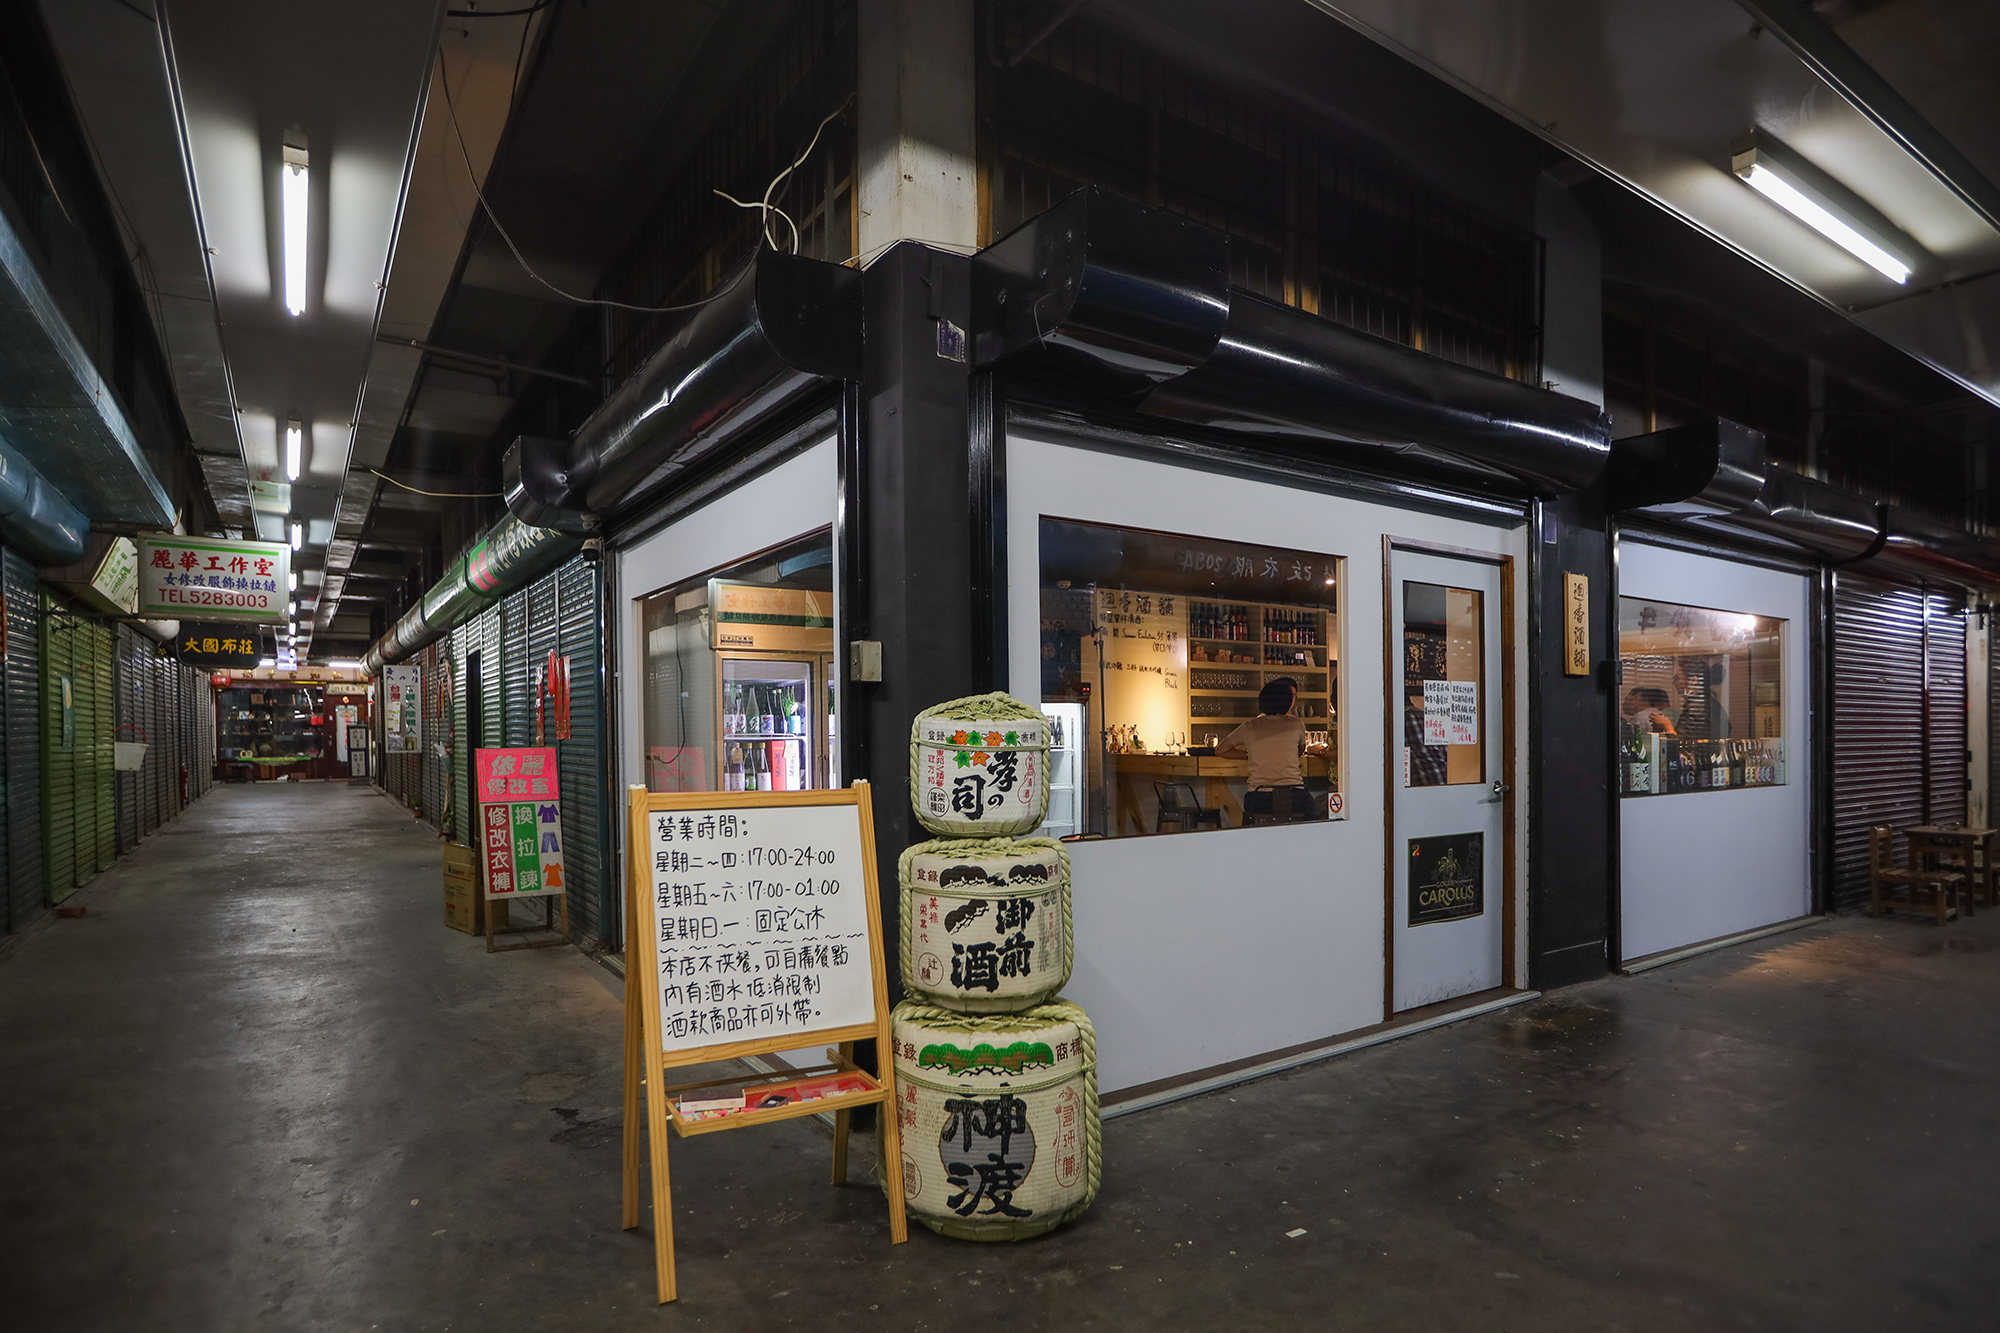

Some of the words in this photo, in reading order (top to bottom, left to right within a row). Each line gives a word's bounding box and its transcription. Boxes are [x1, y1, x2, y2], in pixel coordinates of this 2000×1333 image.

[150, 549, 274, 577] 麗華工作室
[163, 571, 277, 593] 女修改服飾換拉鏈
[159, 588, 268, 608] TEL5283003
[183, 636, 254, 655] 大國布莊
[490, 754, 546, 777] 依麗
[486, 778, 550, 795] 修改室
[487, 806, 511, 891] 修改衣褲
[515, 806, 539, 889] 換拉鍊
[1419, 884, 1475, 907] CAROLUS
